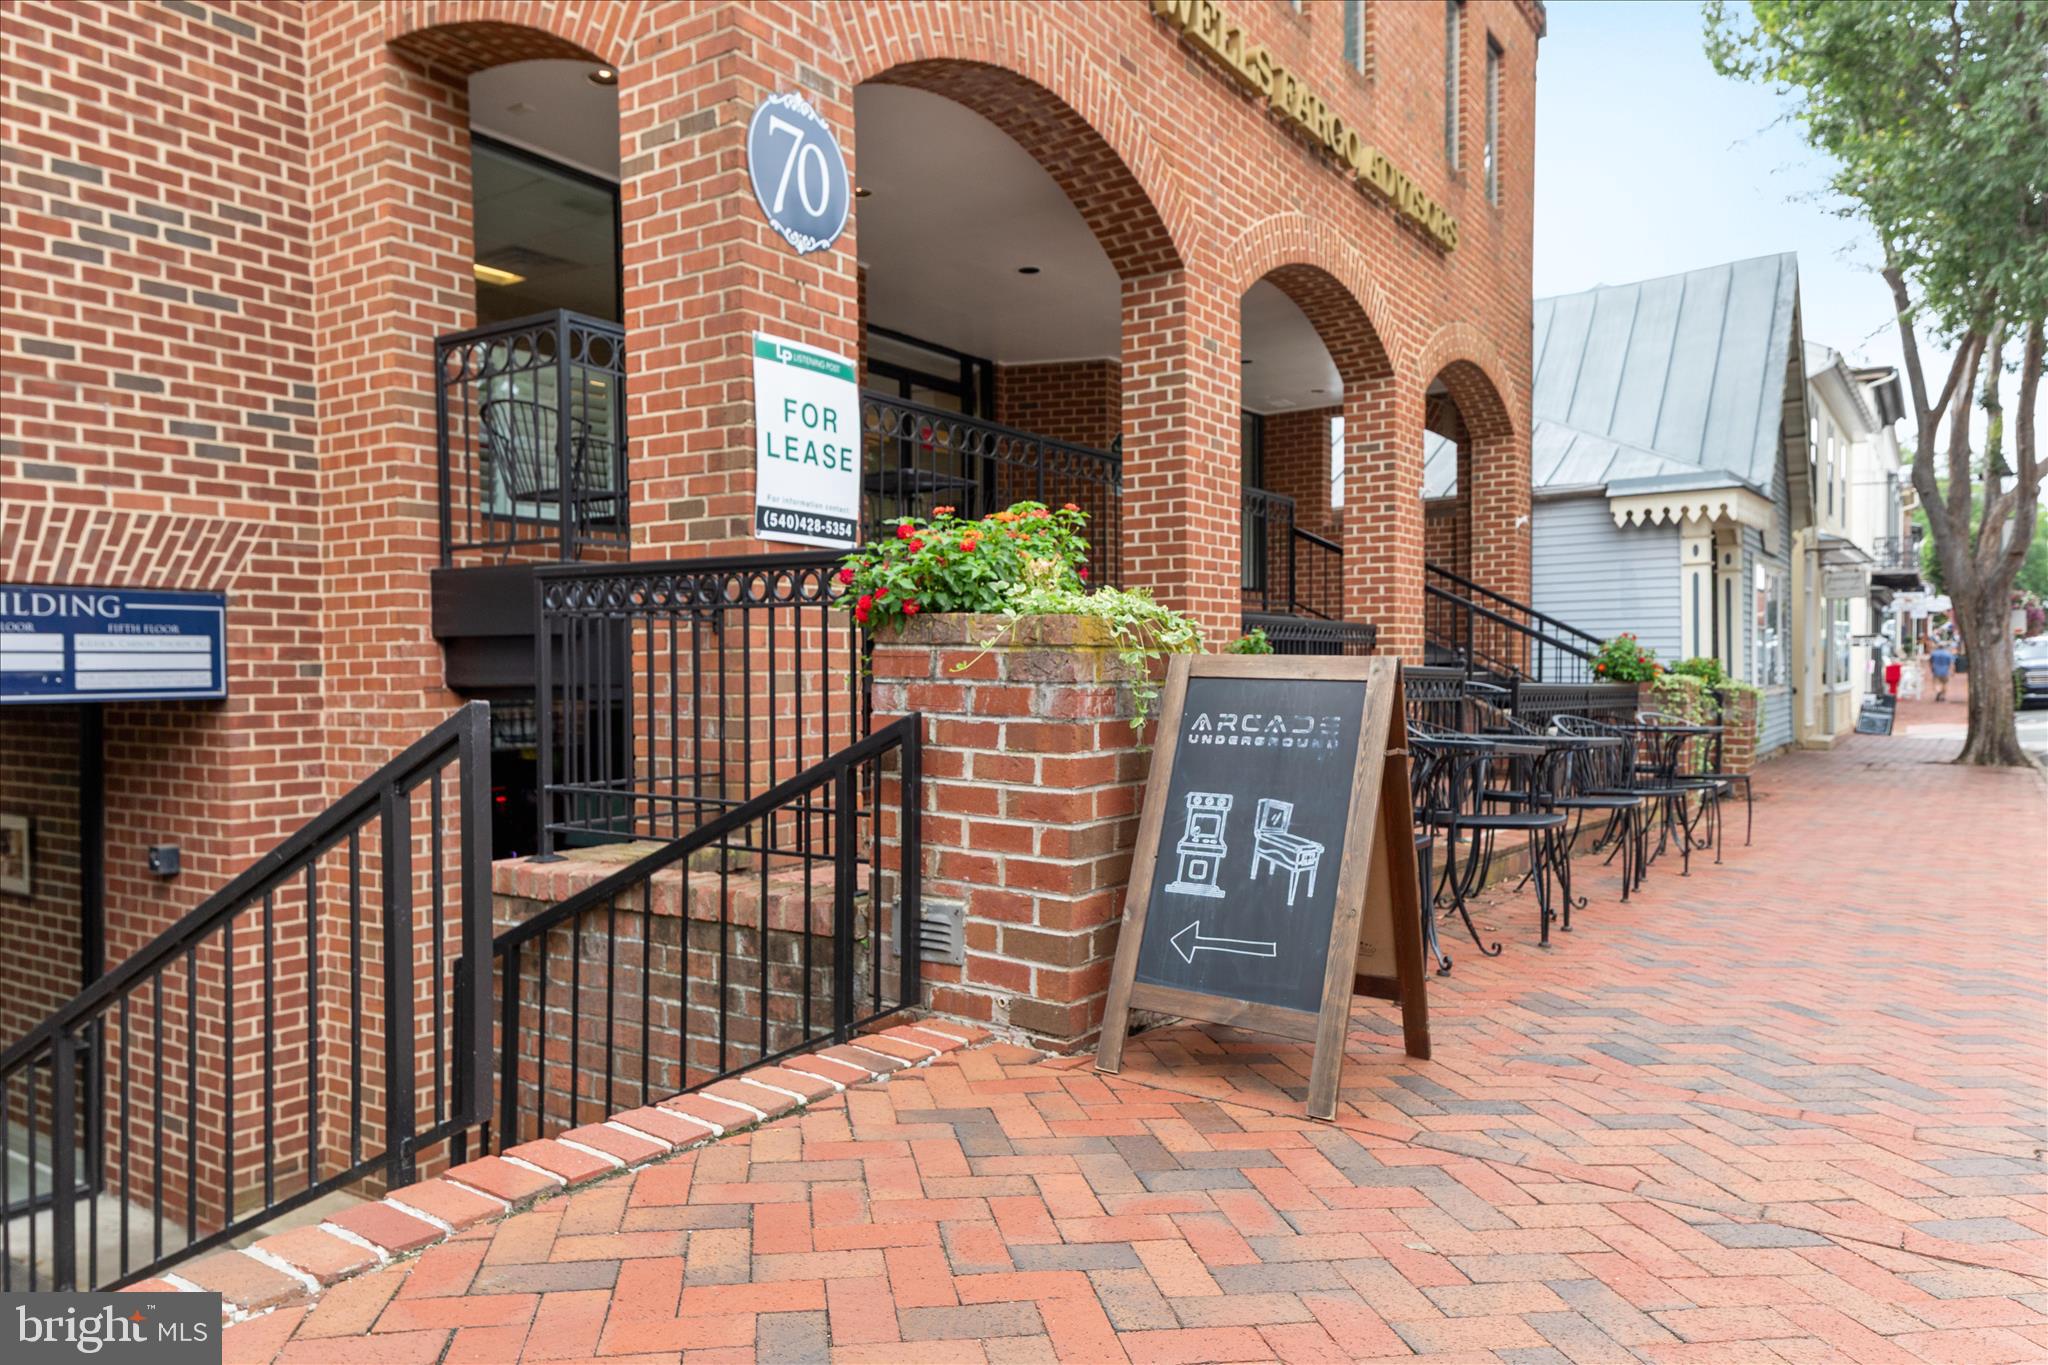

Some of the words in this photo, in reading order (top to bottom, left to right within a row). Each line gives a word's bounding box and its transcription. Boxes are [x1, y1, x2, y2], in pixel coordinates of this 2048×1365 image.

[769, 115, 830, 217] 70
[1272, 69, 1360, 168] FARGO
[1359, 146, 1458, 250] ADVISORS
[784, 398, 837, 433] FOR
[767, 432, 852, 472] LEASE
[763, 510, 852, 537] (540)428-5354
[143, 624, 179, 634] FLOOR
[1191, 713, 1341, 734] ARCADE
